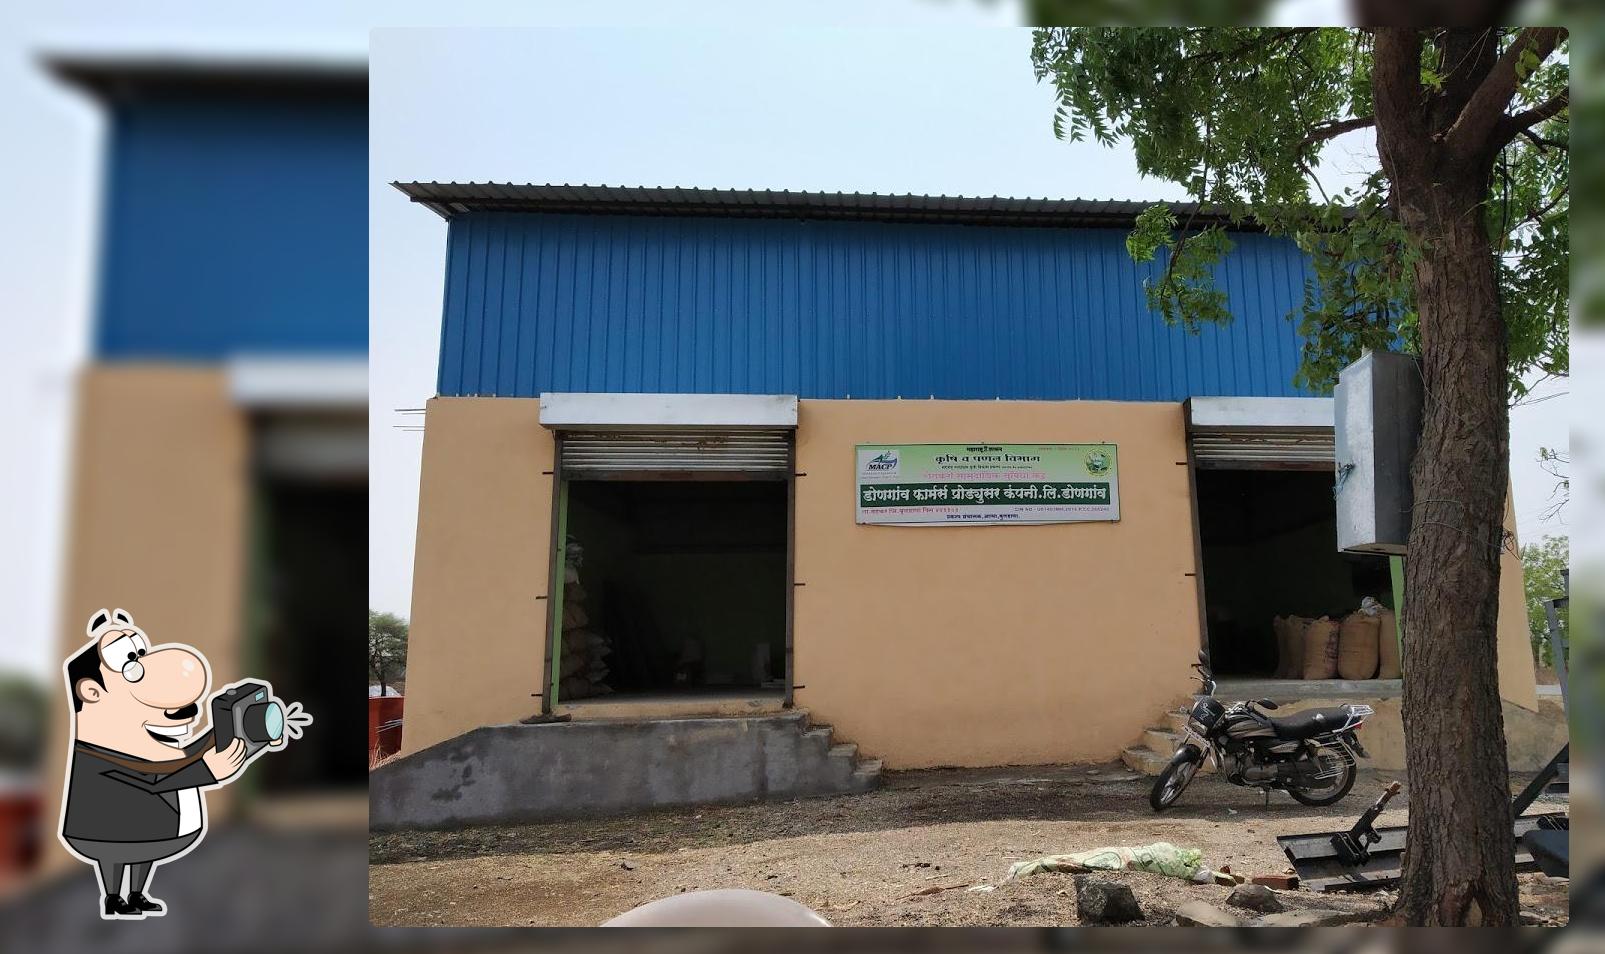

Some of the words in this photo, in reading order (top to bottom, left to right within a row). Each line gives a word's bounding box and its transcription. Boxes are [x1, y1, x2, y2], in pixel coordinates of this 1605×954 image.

[935, 453, 958, 464] कृषि
[1005, 453, 1041, 462] विभाग
[868, 463, 893, 471] MACP
[862, 485, 910, 501] डोणगांव
[913, 484, 948, 500] फार्मर्स
[950, 484, 1000, 504] प्रोड्युसर
